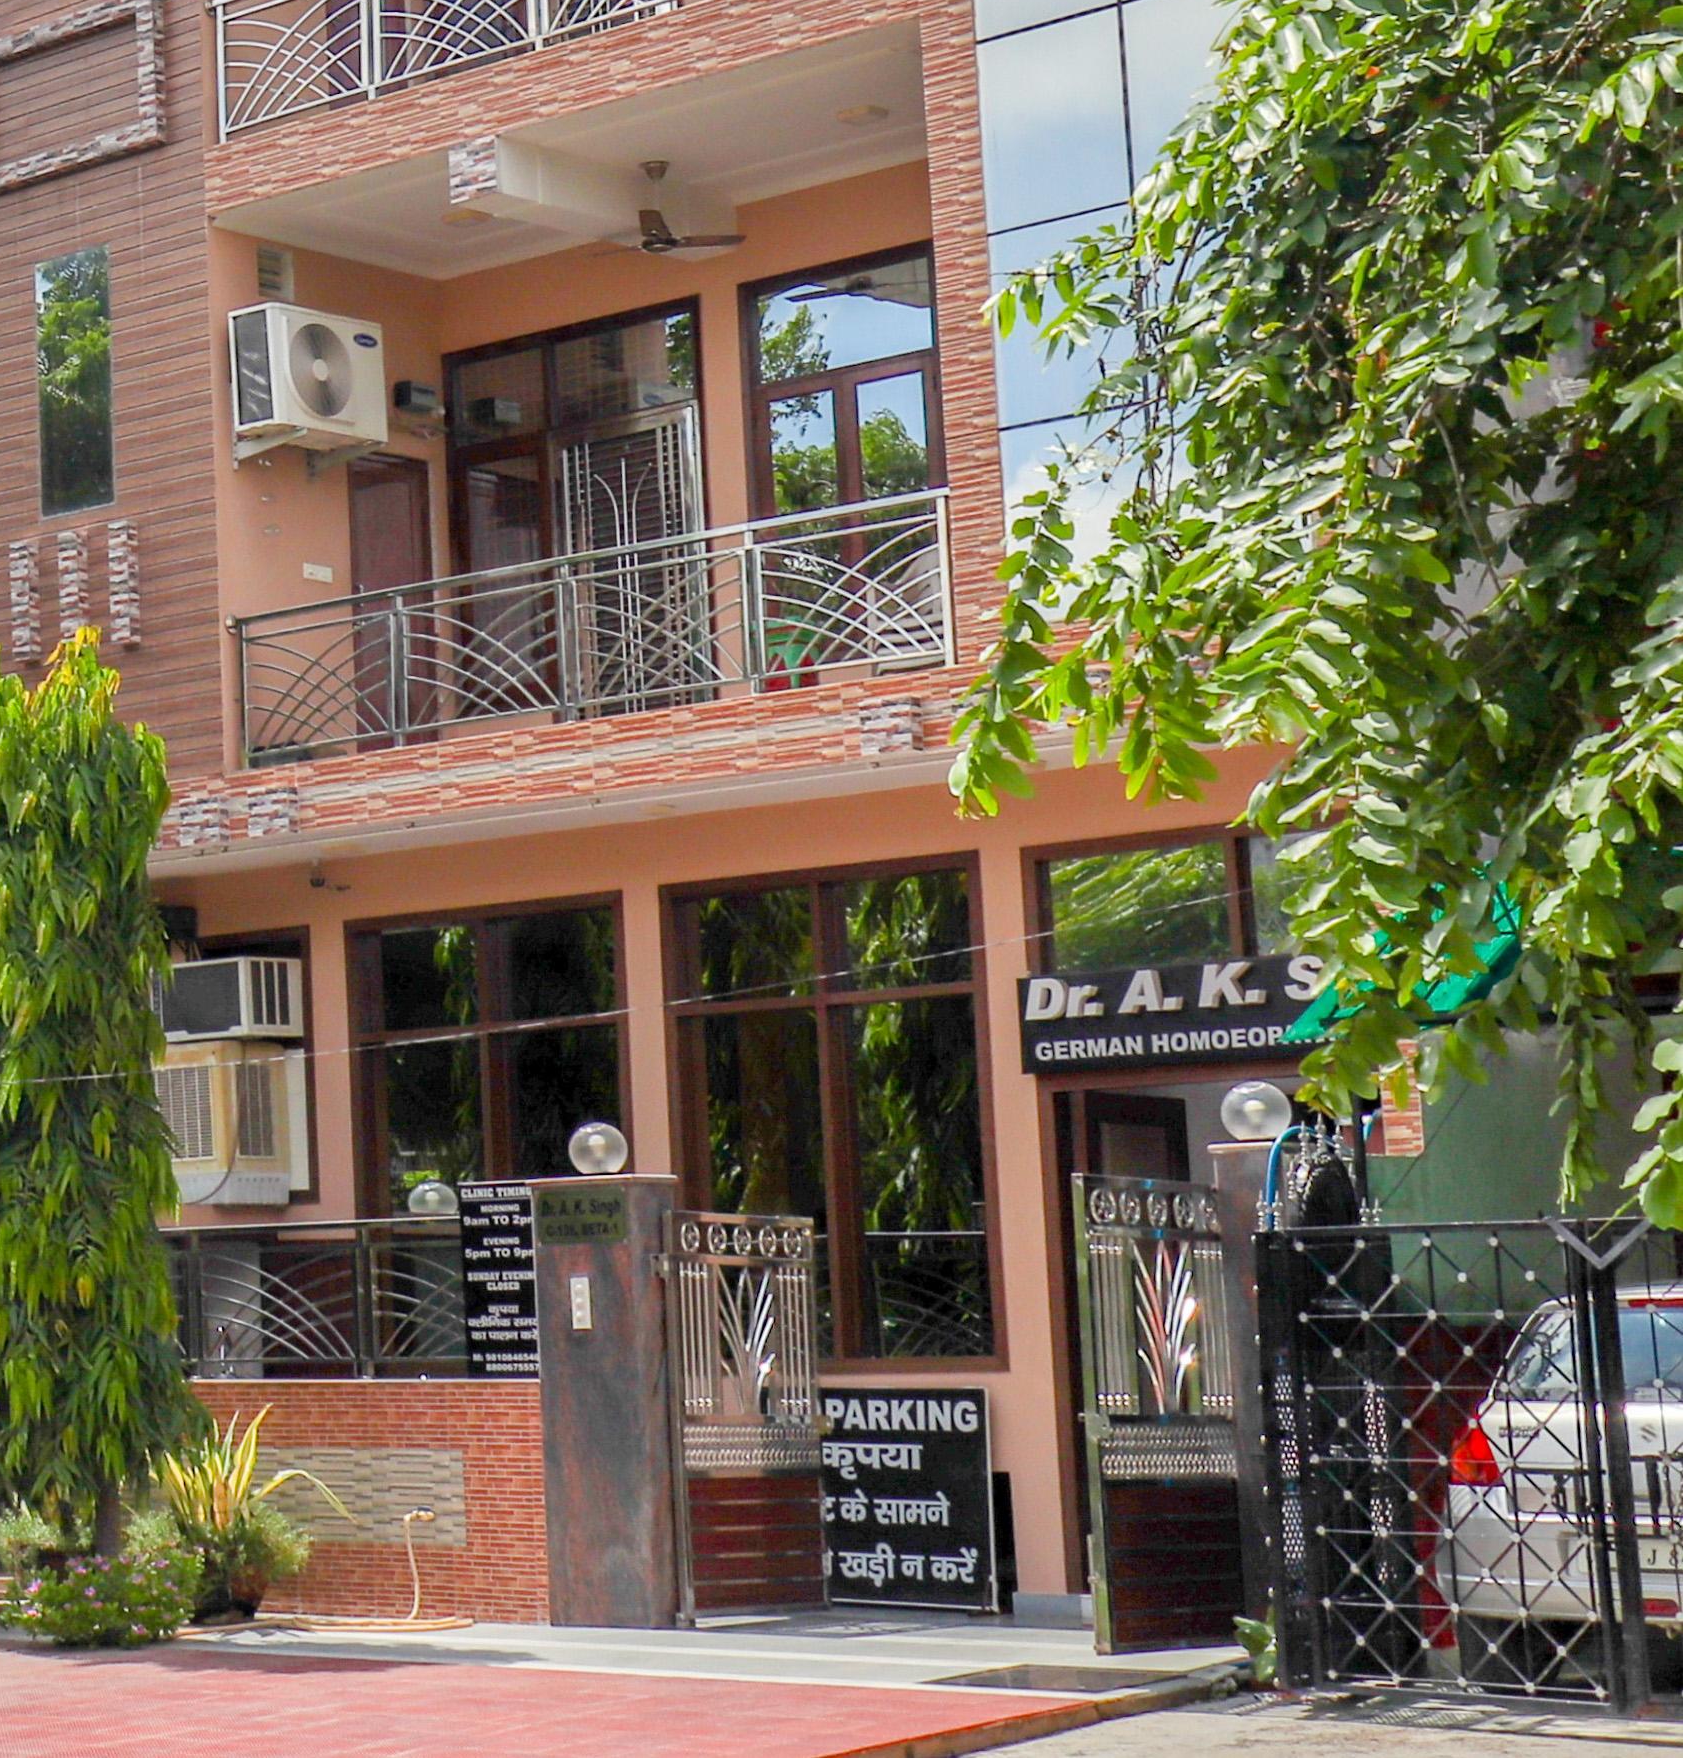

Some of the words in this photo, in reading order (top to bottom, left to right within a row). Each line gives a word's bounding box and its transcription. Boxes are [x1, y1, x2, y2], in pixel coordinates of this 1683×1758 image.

[1025, 978, 1104, 1021] Dr.
[1118, 969, 1183, 1014] A.
[1198, 960, 1267, 1007] K.
[1035, 1035, 1144, 1062] GERMAN
[460, 1187, 494, 1198] CLINIC
[480, 1203, 520, 1213] MORNING
[463, 1215, 490, 1226] 9am
[491, 1215, 509, 1226] TO
[482, 1237, 520, 1246] EVENING
[465, 1248, 491, 1260] 5pm
[493, 1247, 511, 1258] TO
[467, 1271, 501, 1282] SUNDAY
[486, 1281, 520, 1291] CLOSED
[826, 1399, 979, 1433] PARKING
[822, 1441, 923, 1481] कृपया
[839, 1488, 869, 1523] के
[874, 1491, 951, 1527] सामने
[839, 1542, 895, 1588] खड़ी
[900, 1555, 925, 1581] न
[930, 1546, 979, 1583] करें
